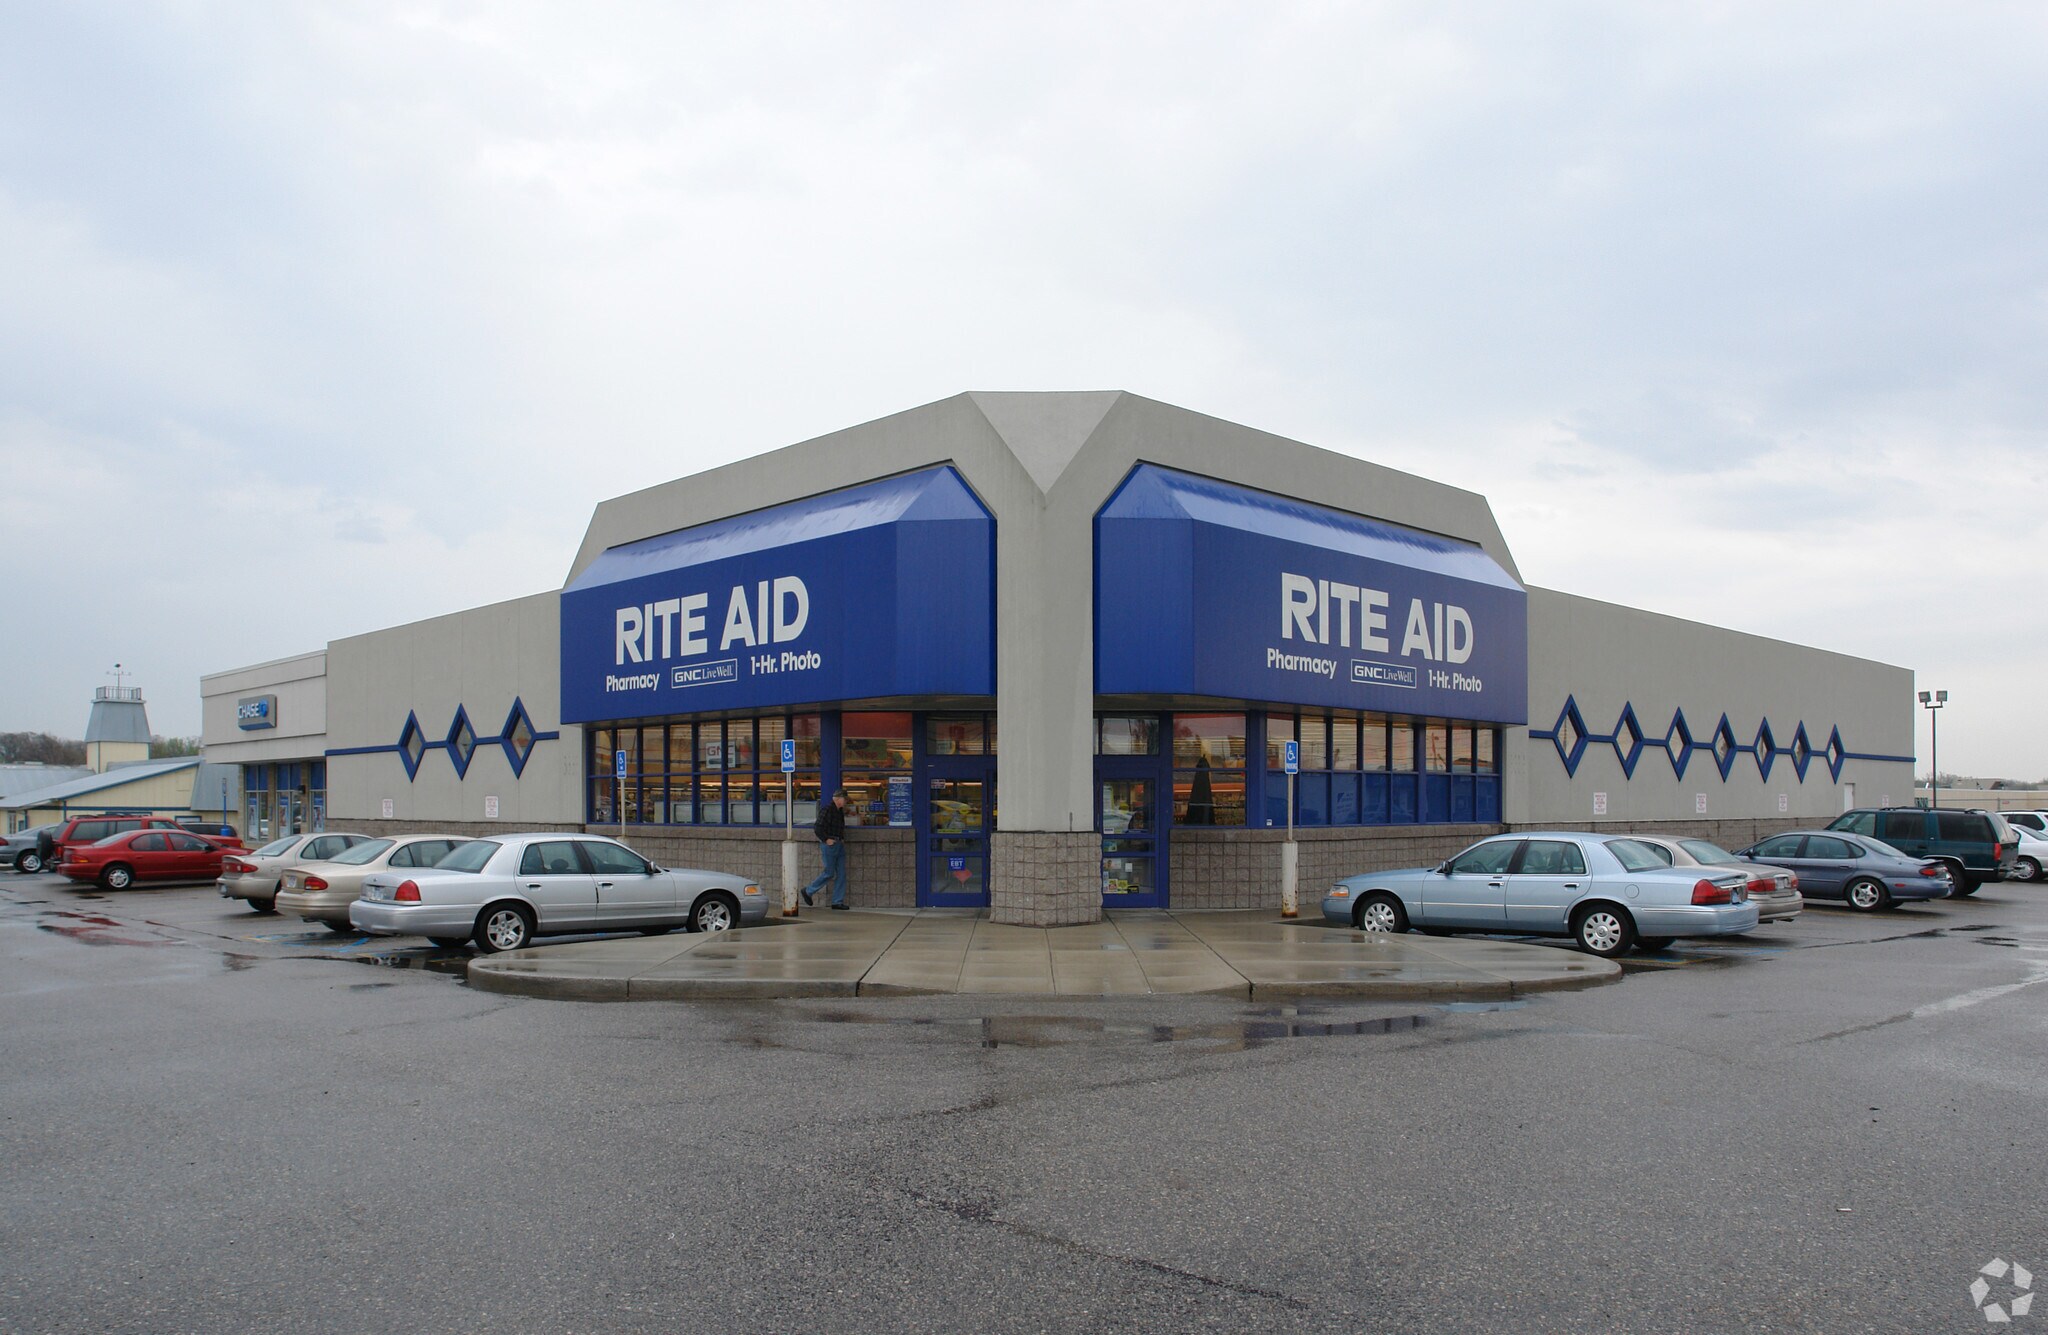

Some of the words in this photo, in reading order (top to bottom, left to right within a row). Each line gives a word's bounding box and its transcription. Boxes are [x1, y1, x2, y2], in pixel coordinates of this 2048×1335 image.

[616, 592, 708, 665] RITE
[720, 575, 809, 651] AID
[1281, 572, 1389, 653] RITE
[1401, 598, 1474, 664] AID
[750, 654, 778, 675] 1-Hr.
[780, 650, 821, 672] Photo
[1267, 648, 1337, 679] Pharmacy
[1354, 665, 1383, 679] GNC
[606, 673, 660, 692] Pharmacy
[674, 669, 702, 683] GNC
[1428, 669, 1451, 689] 1-Hr.
[1453, 673, 1482, 693] Photo
[238, 703, 260, 718] CHASE
